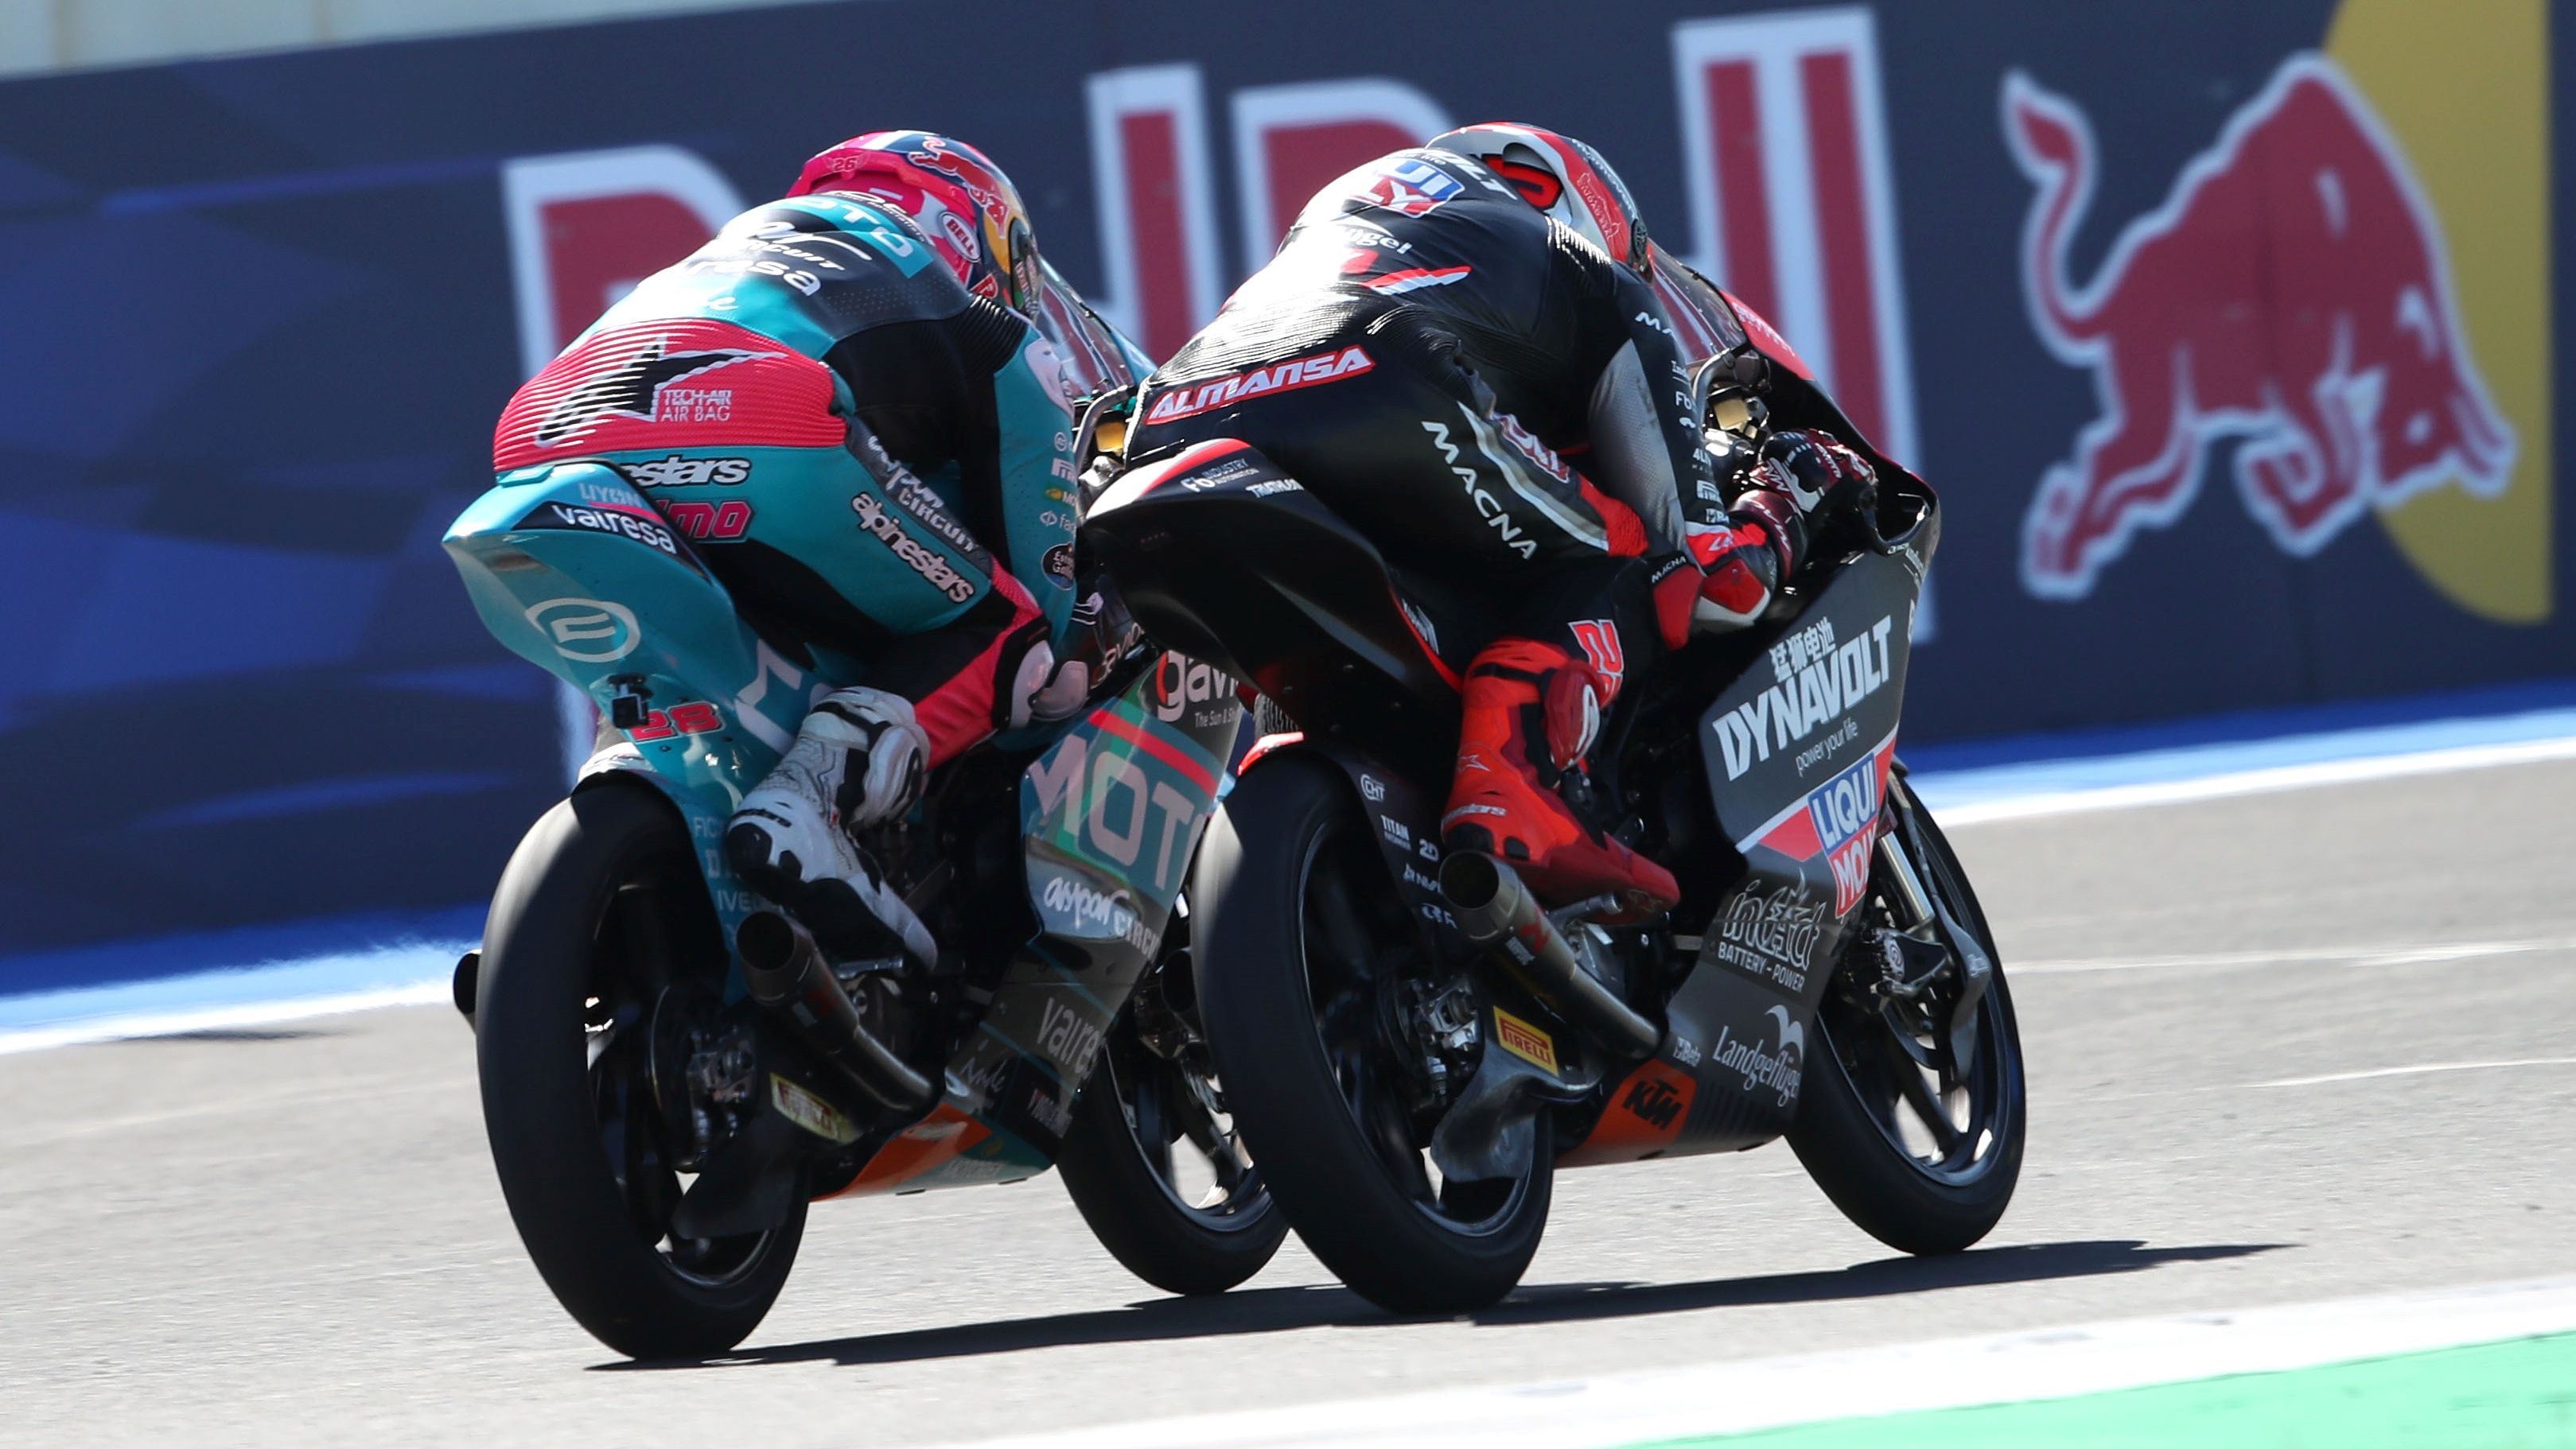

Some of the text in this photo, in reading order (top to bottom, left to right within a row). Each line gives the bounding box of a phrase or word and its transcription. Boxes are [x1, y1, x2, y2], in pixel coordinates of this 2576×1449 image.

[946, 219, 975, 257] BELL
[1150, 347, 1372, 420] ALMANSA
[660, 406, 730, 422] AIR BAG
[1422, 421, 1537, 559] MACNA
[851, 491, 975, 603] alpinestars
[1651, 556, 1687, 584] MACNA
[1156, 650, 1239, 722] gavi
[1712, 614, 1892, 782] DYNAVOLT
[1796, 742, 1824, 777] power
[1823, 732, 1845, 760] your
[1380, 814, 1410, 841] TITAN
[1812, 759, 1875, 849] LIQUI
[1718, 942, 1767, 974] BATTERY
[1772, 964, 1805, 993] POWER
[1500, 1017, 1552, 1064] PIRELLI
[1622, 1078, 1684, 1131] KTM
